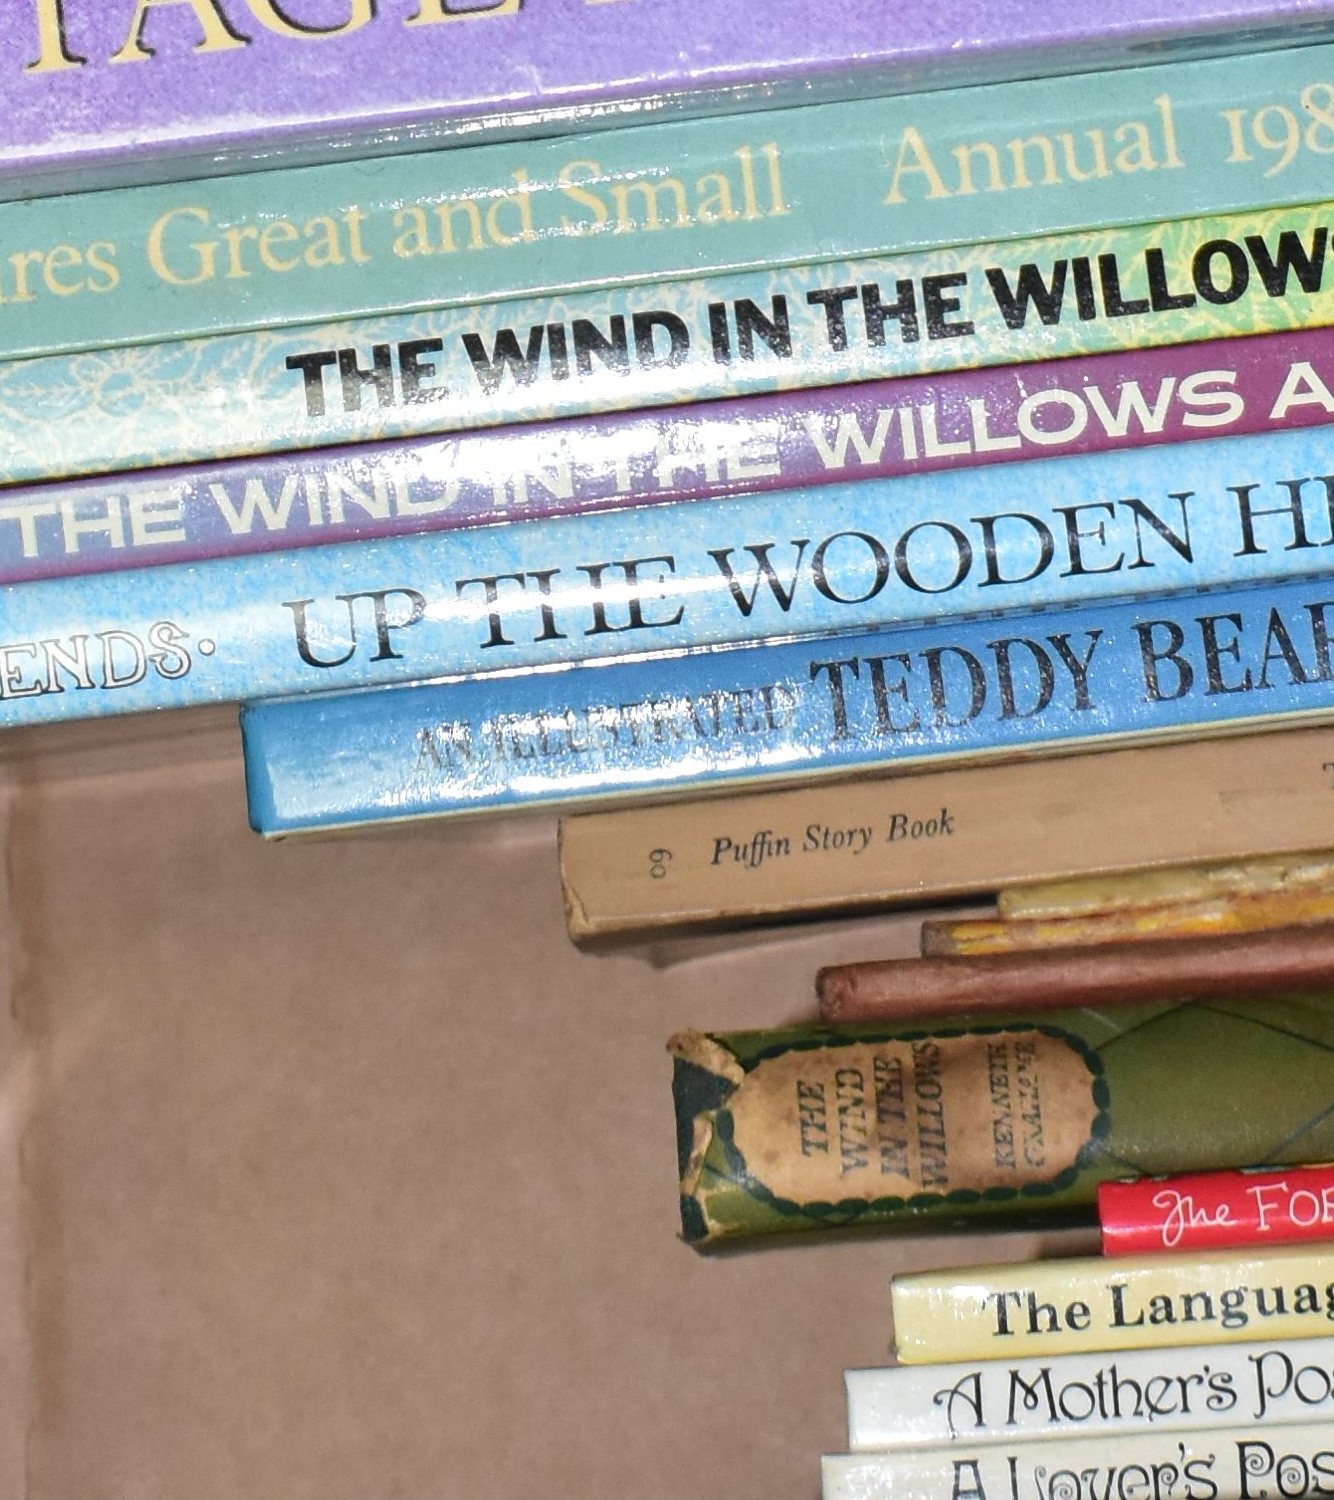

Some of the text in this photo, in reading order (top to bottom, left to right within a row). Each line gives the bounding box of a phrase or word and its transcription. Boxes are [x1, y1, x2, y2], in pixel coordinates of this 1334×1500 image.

[148, 205, 367, 287] Great
[392, 166, 531, 257] and
[557, 140, 785, 235] Small
[883, 95, 1182, 205] Annual
[287, 337, 444, 417] THE
[462, 308, 690, 391] WIND
[707, 293, 792, 362] IN
[808, 272, 975, 353] THE
[207, 460, 460, 534] WIND
[492, 449, 574, 509] IN
[806, 369, 1244, 470] WILLOWS
[291, 584, 428, 670] UP
[456, 554, 688, 651] THE
[708, 492, 1195, 616] WOODEN
[810, 629, 1105, 741] TEDDY
[712, 833, 794, 868] Puffin
[803, 819, 874, 860] Story
[887, 810, 955, 839] Book
[797, 1080, 830, 1158] THE
[836, 1067, 869, 1178] WIND
[873, 1055, 905, 1127] THE
[914, 1038, 952, 1191] WILLOWS
[1153, 1189, 1235, 1247] The
[984, 1286, 1092, 1338] The
[934, 1371, 984, 1428] A
[1017, 1367, 1237, 1425] Mother's
